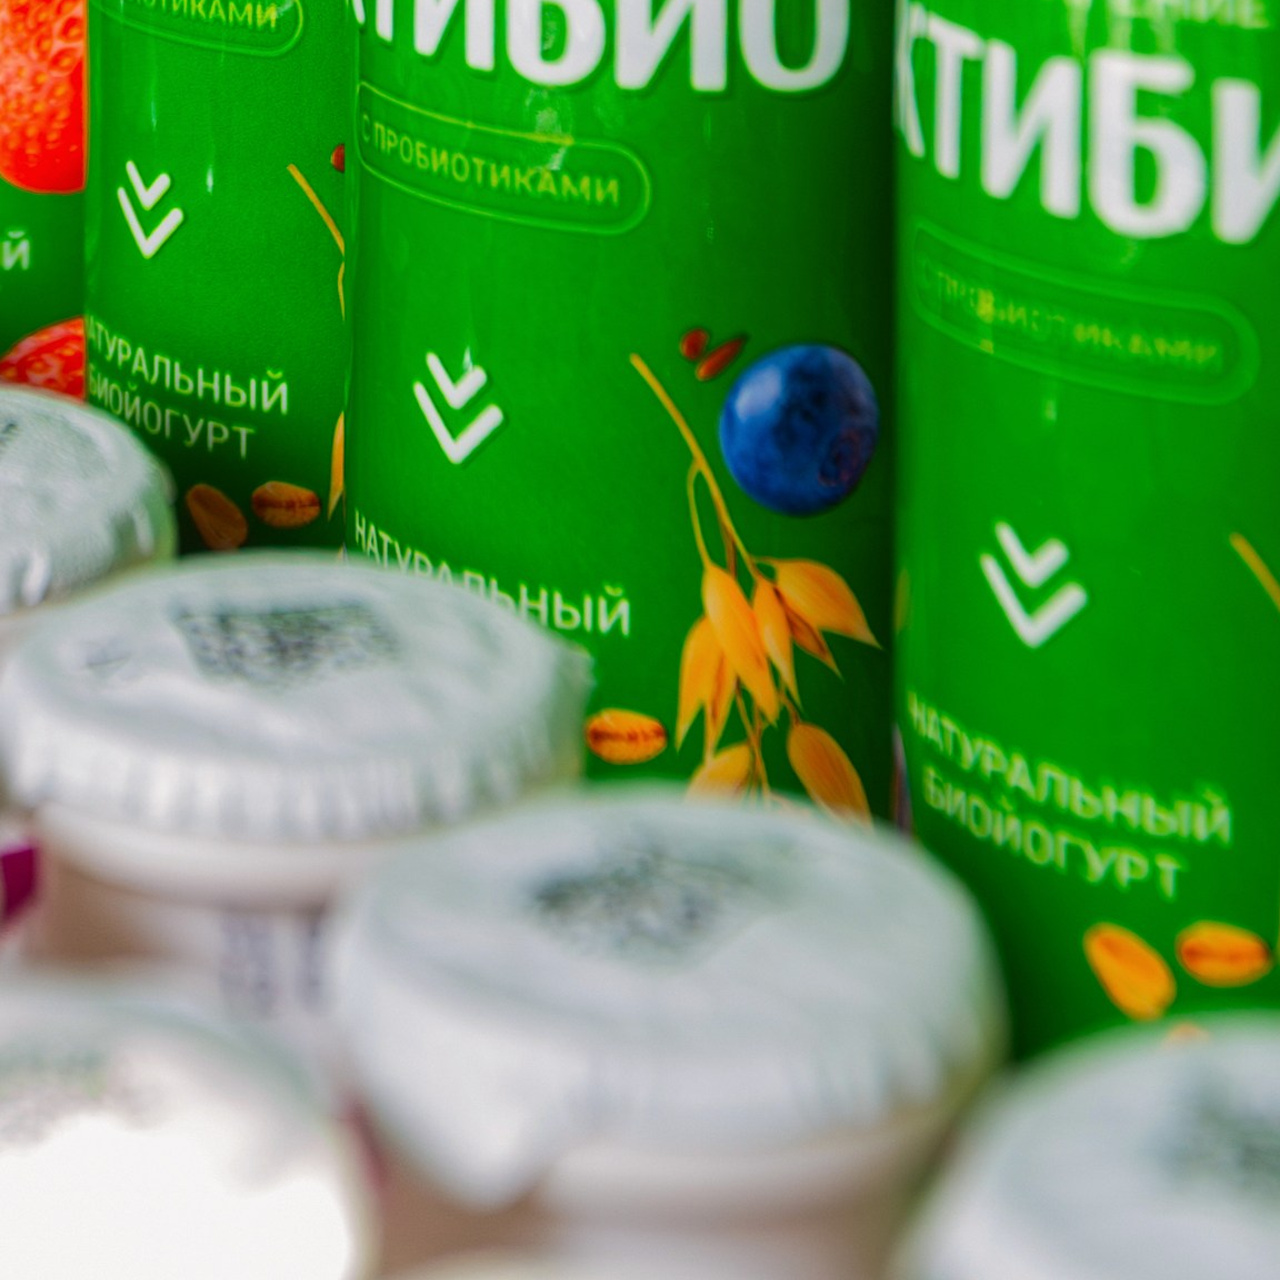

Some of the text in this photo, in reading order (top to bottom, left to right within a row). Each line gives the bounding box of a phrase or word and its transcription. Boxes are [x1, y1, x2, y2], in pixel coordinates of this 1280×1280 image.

[373, 121, 620, 206] ПРОБИОТИКАМИ
[907, 689, 1234, 847] НАТУРАЛЬНЫЙ
[923, 764, 1186, 901] БИОЙОГУРТ
